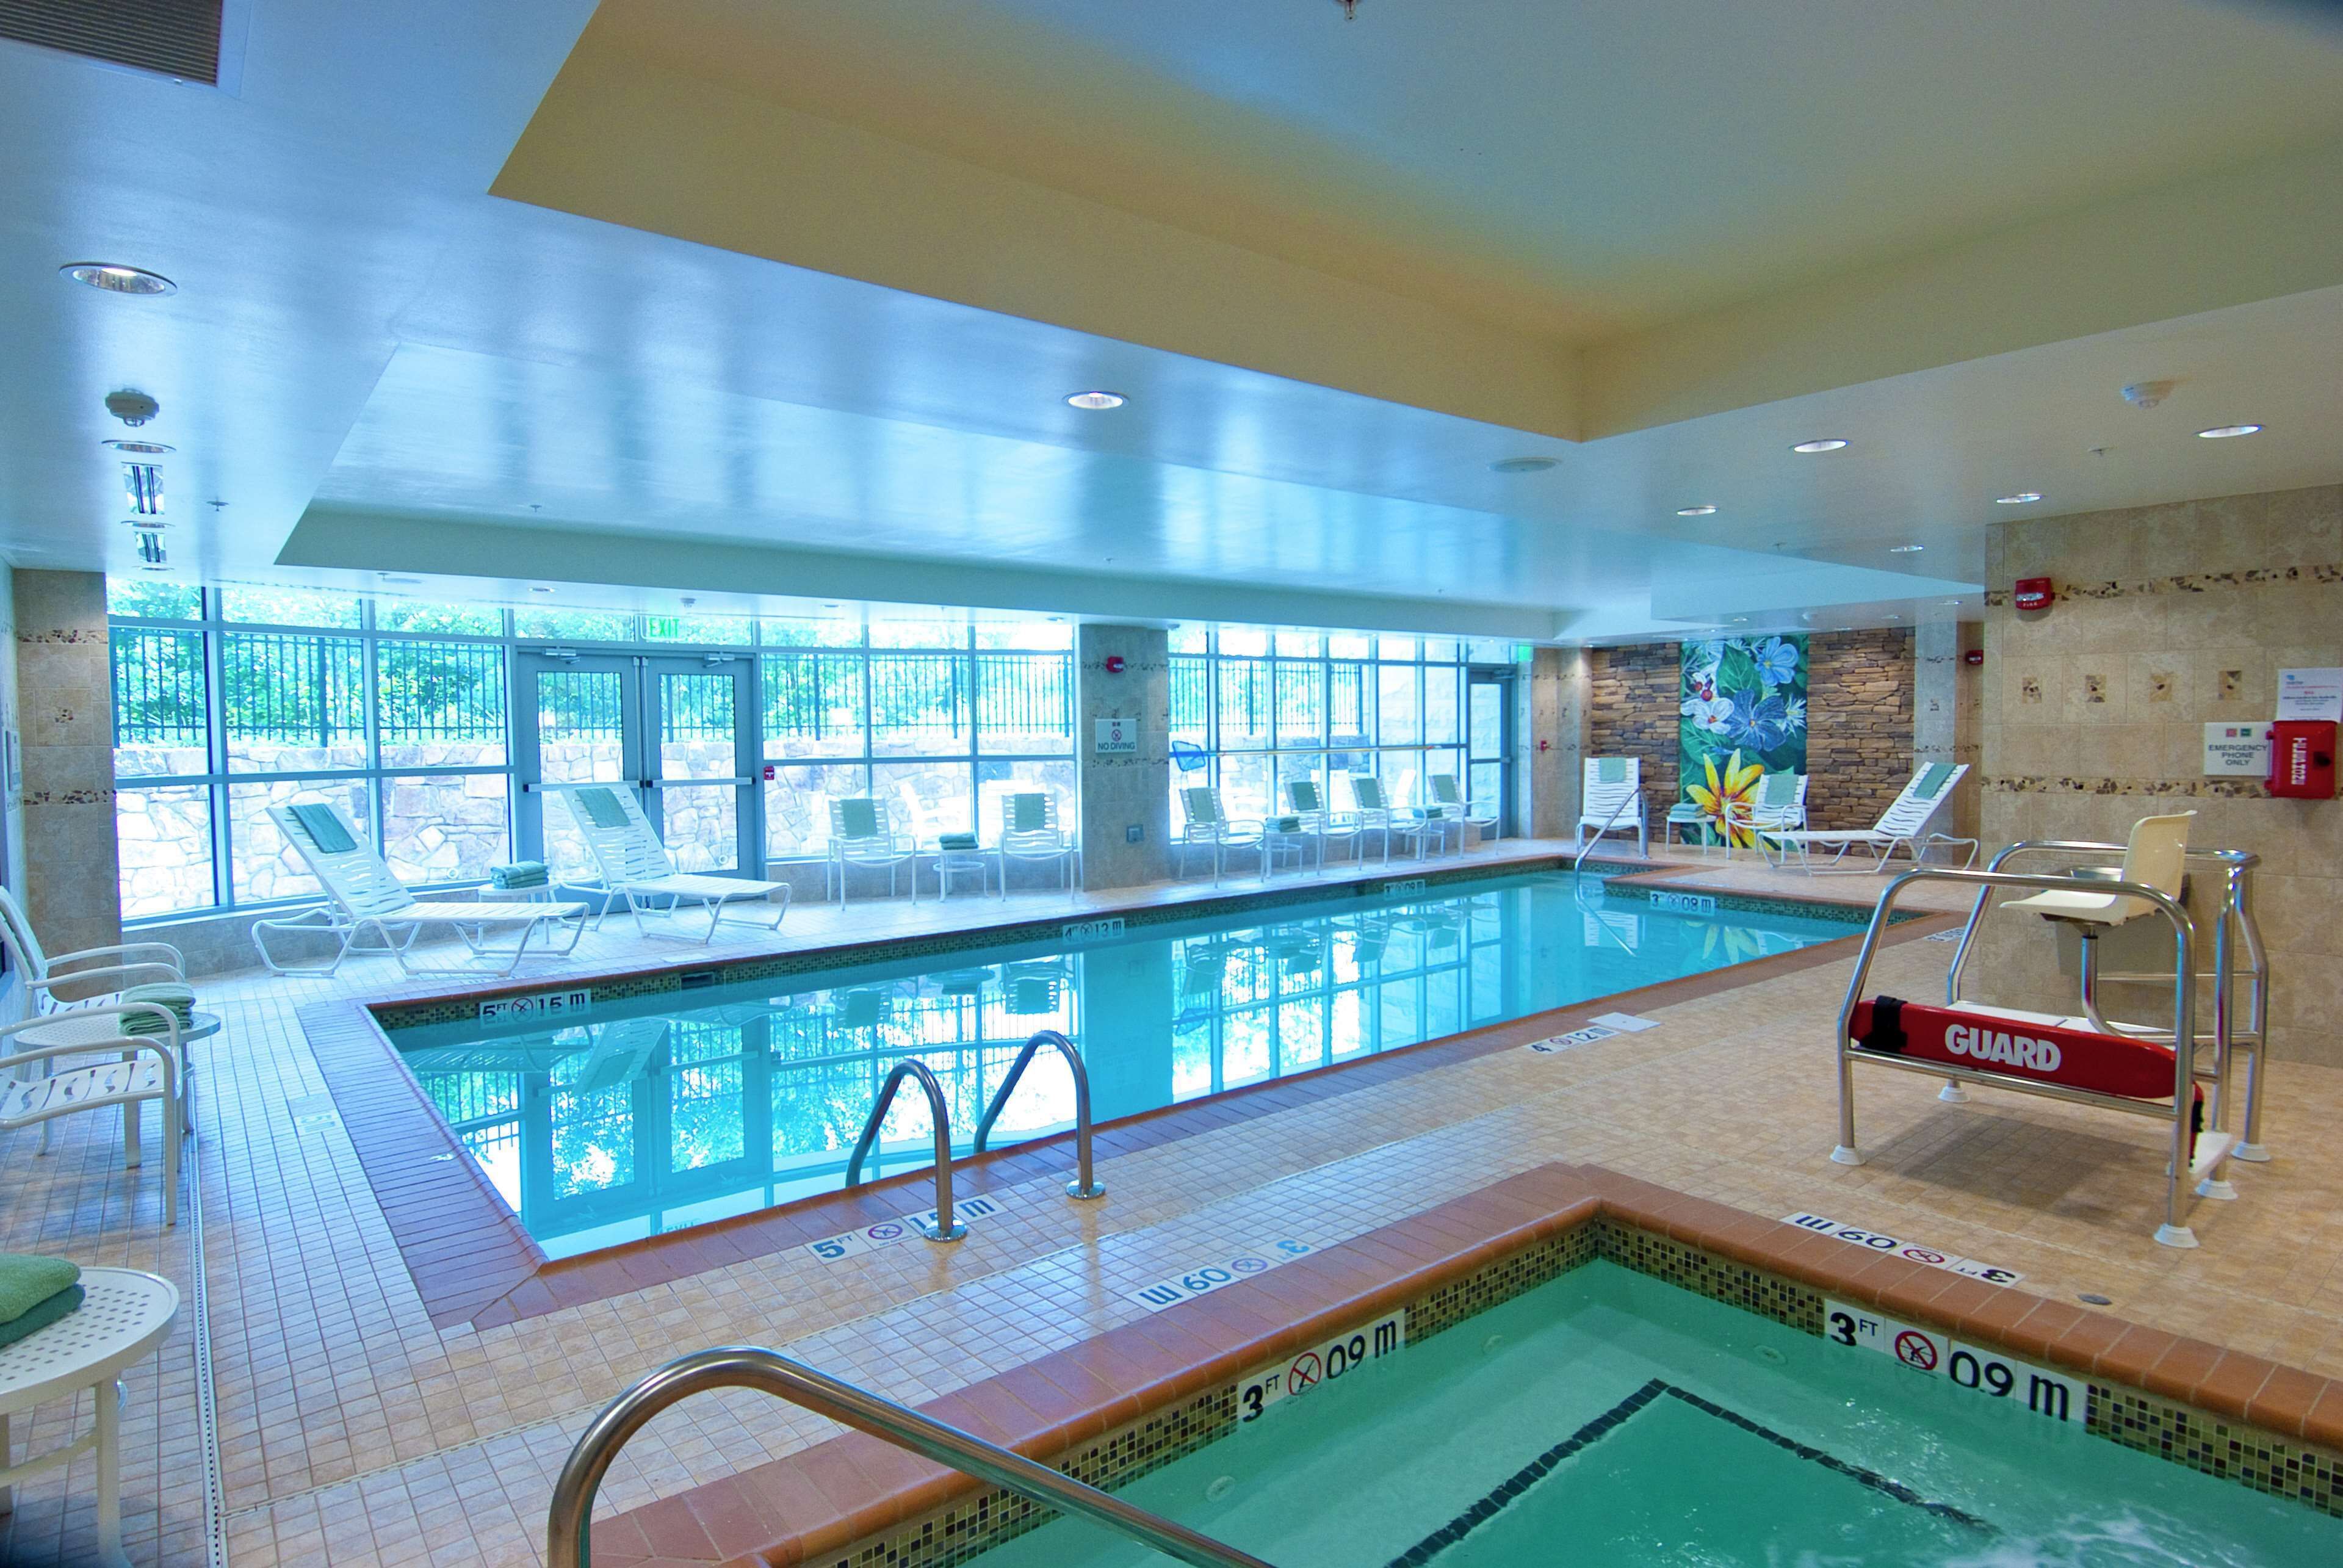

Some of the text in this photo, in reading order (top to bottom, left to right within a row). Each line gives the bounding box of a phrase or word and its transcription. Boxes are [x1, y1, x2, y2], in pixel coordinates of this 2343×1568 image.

[649, 618, 679, 638] EXIT
[1098, 742, 1135, 750] NO DIVING
[570, 992, 585, 1006] m
[1944, 1024, 2061, 1072] GUARD
[812, 1240, 845, 1259] 5
[959, 1199, 996, 1218] m
[1795, 1215, 1835, 1231] m
[1276, 1240, 1309, 1253] 3
[1980, 1268, 2016, 1283] 3
[1138, 1285, 1183, 1305] m
[1243, 1384, 1264, 1423] 3
[1265, 1374, 1280, 1395] FT
[1374, 1320, 1396, 1359] m
[1830, 1312, 1857, 1346] 3
[1859, 1318, 1879, 1337] FT
[2029, 1374, 2069, 1422] m
